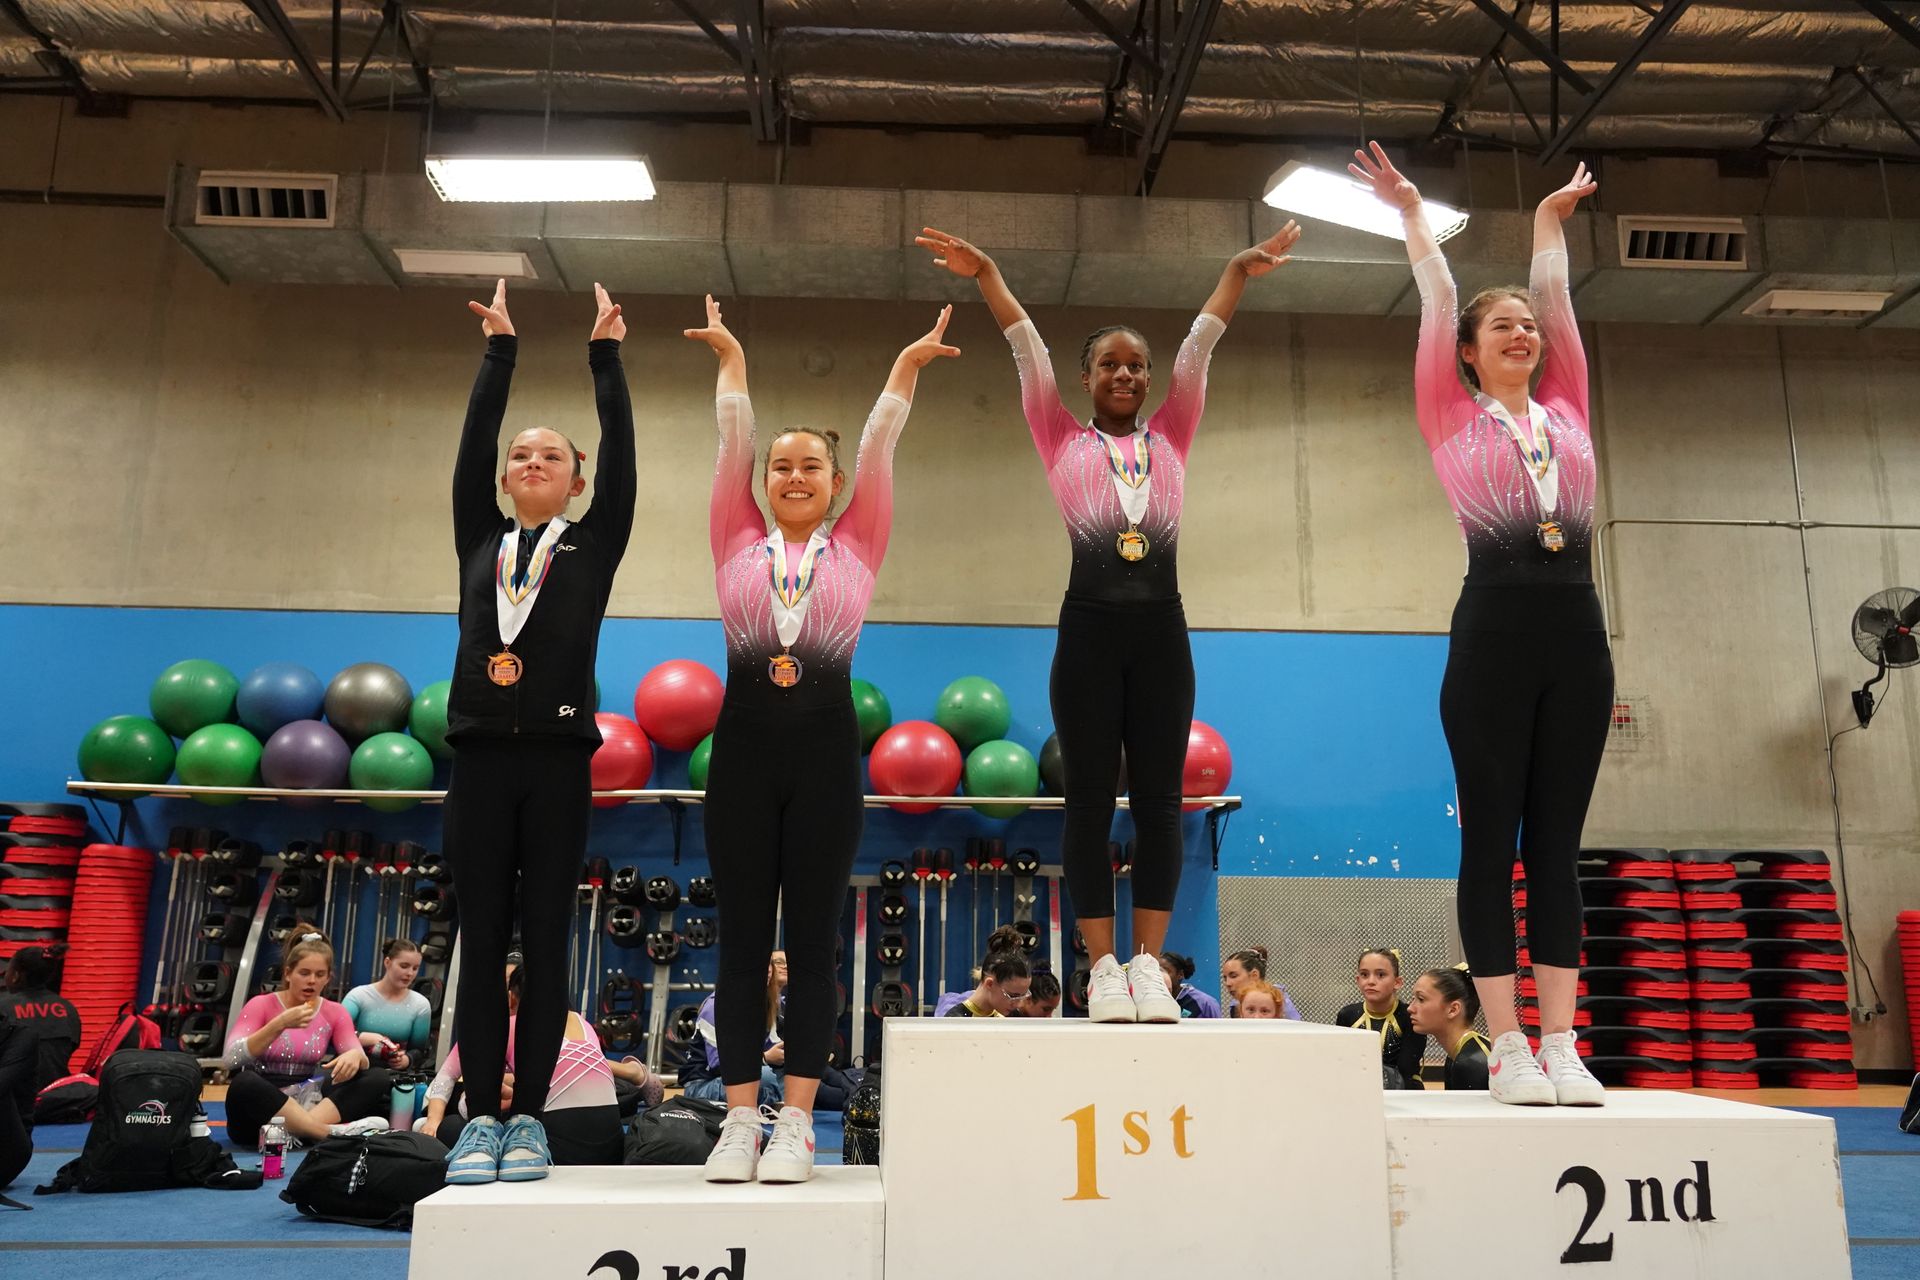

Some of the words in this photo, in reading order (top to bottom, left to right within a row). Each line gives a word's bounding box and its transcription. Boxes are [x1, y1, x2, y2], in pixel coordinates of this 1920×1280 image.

[15, 1002, 68, 1019] MVG
[125, 1115, 171, 1124] GYMNASTICS
[1061, 1103, 1194, 1200] 1st
[1556, 1161, 1716, 1264] 2nd
